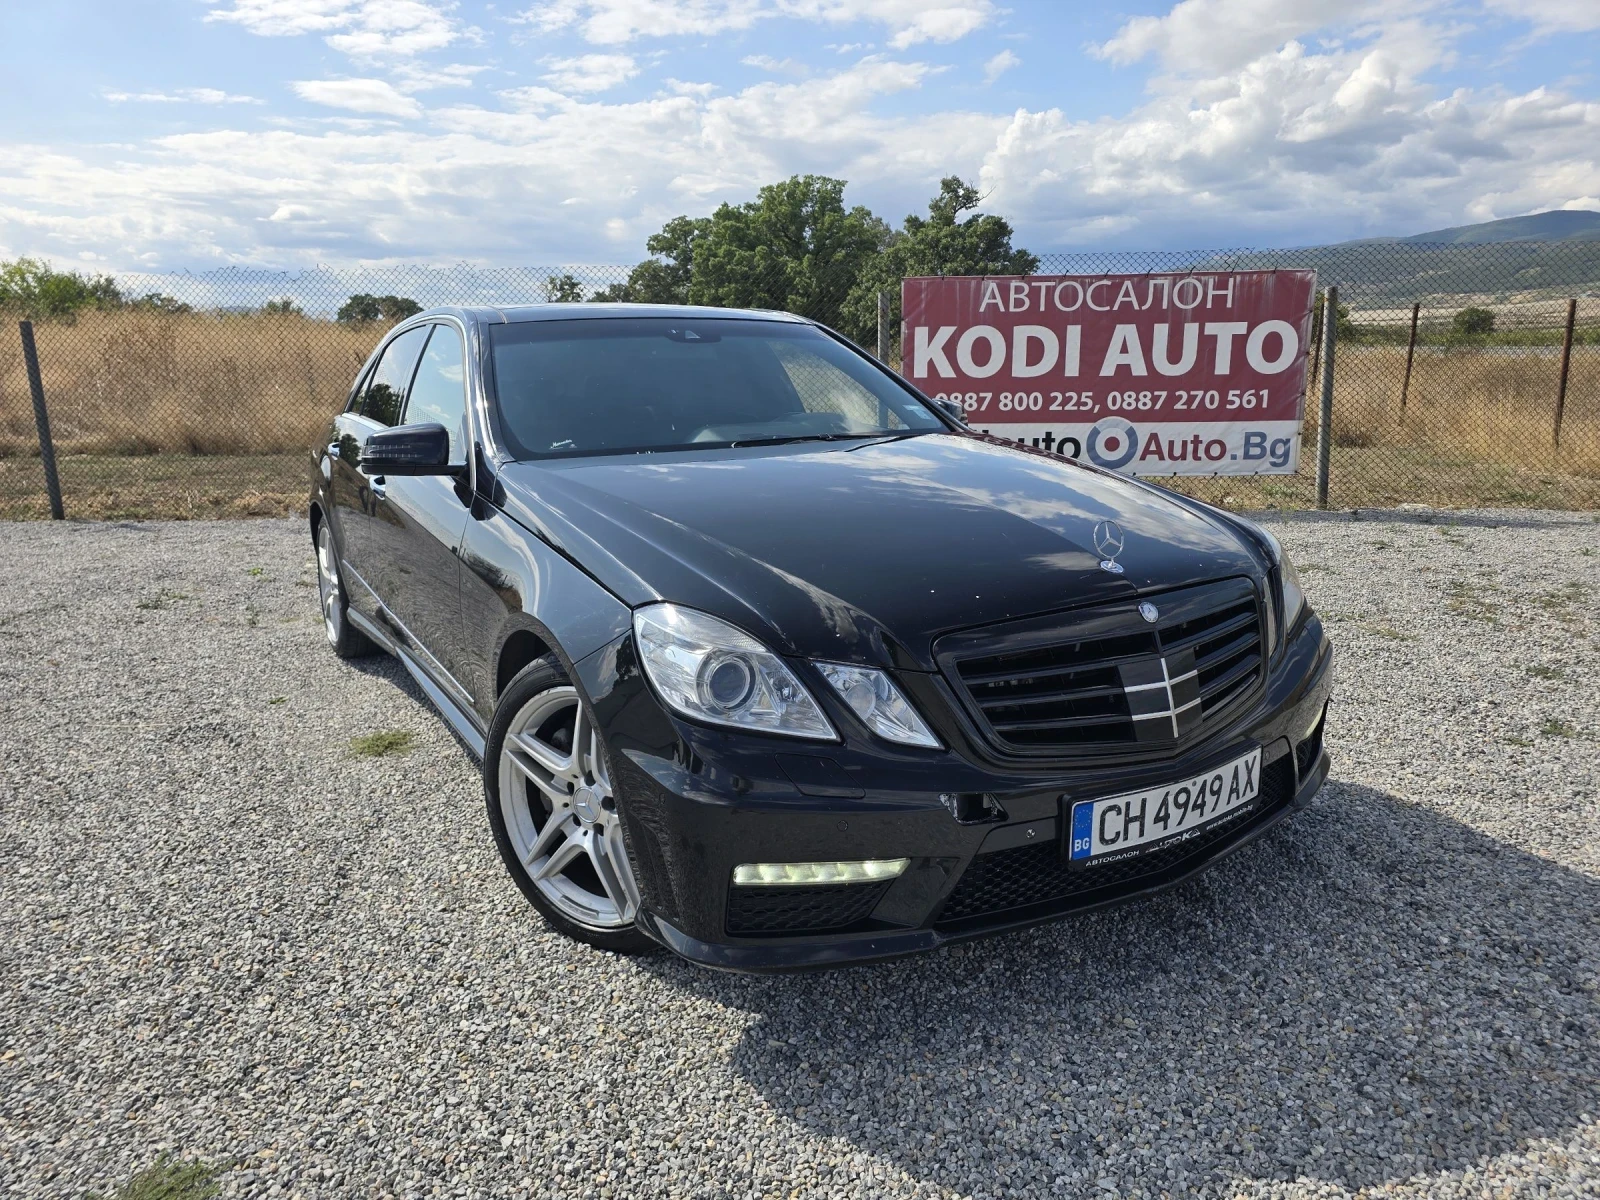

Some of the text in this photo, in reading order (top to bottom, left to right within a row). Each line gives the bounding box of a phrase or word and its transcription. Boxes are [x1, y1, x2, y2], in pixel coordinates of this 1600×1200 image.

[979, 278, 1235, 313] АВТОСАЛОН
[913, 320, 1299, 379] KODI AUTO
[998, 392, 1043, 411] 800
[1049, 391, 1101, 414] 225,
[1107, 390, 1168, 410] 0887
[1173, 390, 1220, 410] 270
[1226, 389, 1270, 409] 561
[1074, 837, 1090, 852] BG
[1085, 849, 1140, 867] АВТОСАЛОН
